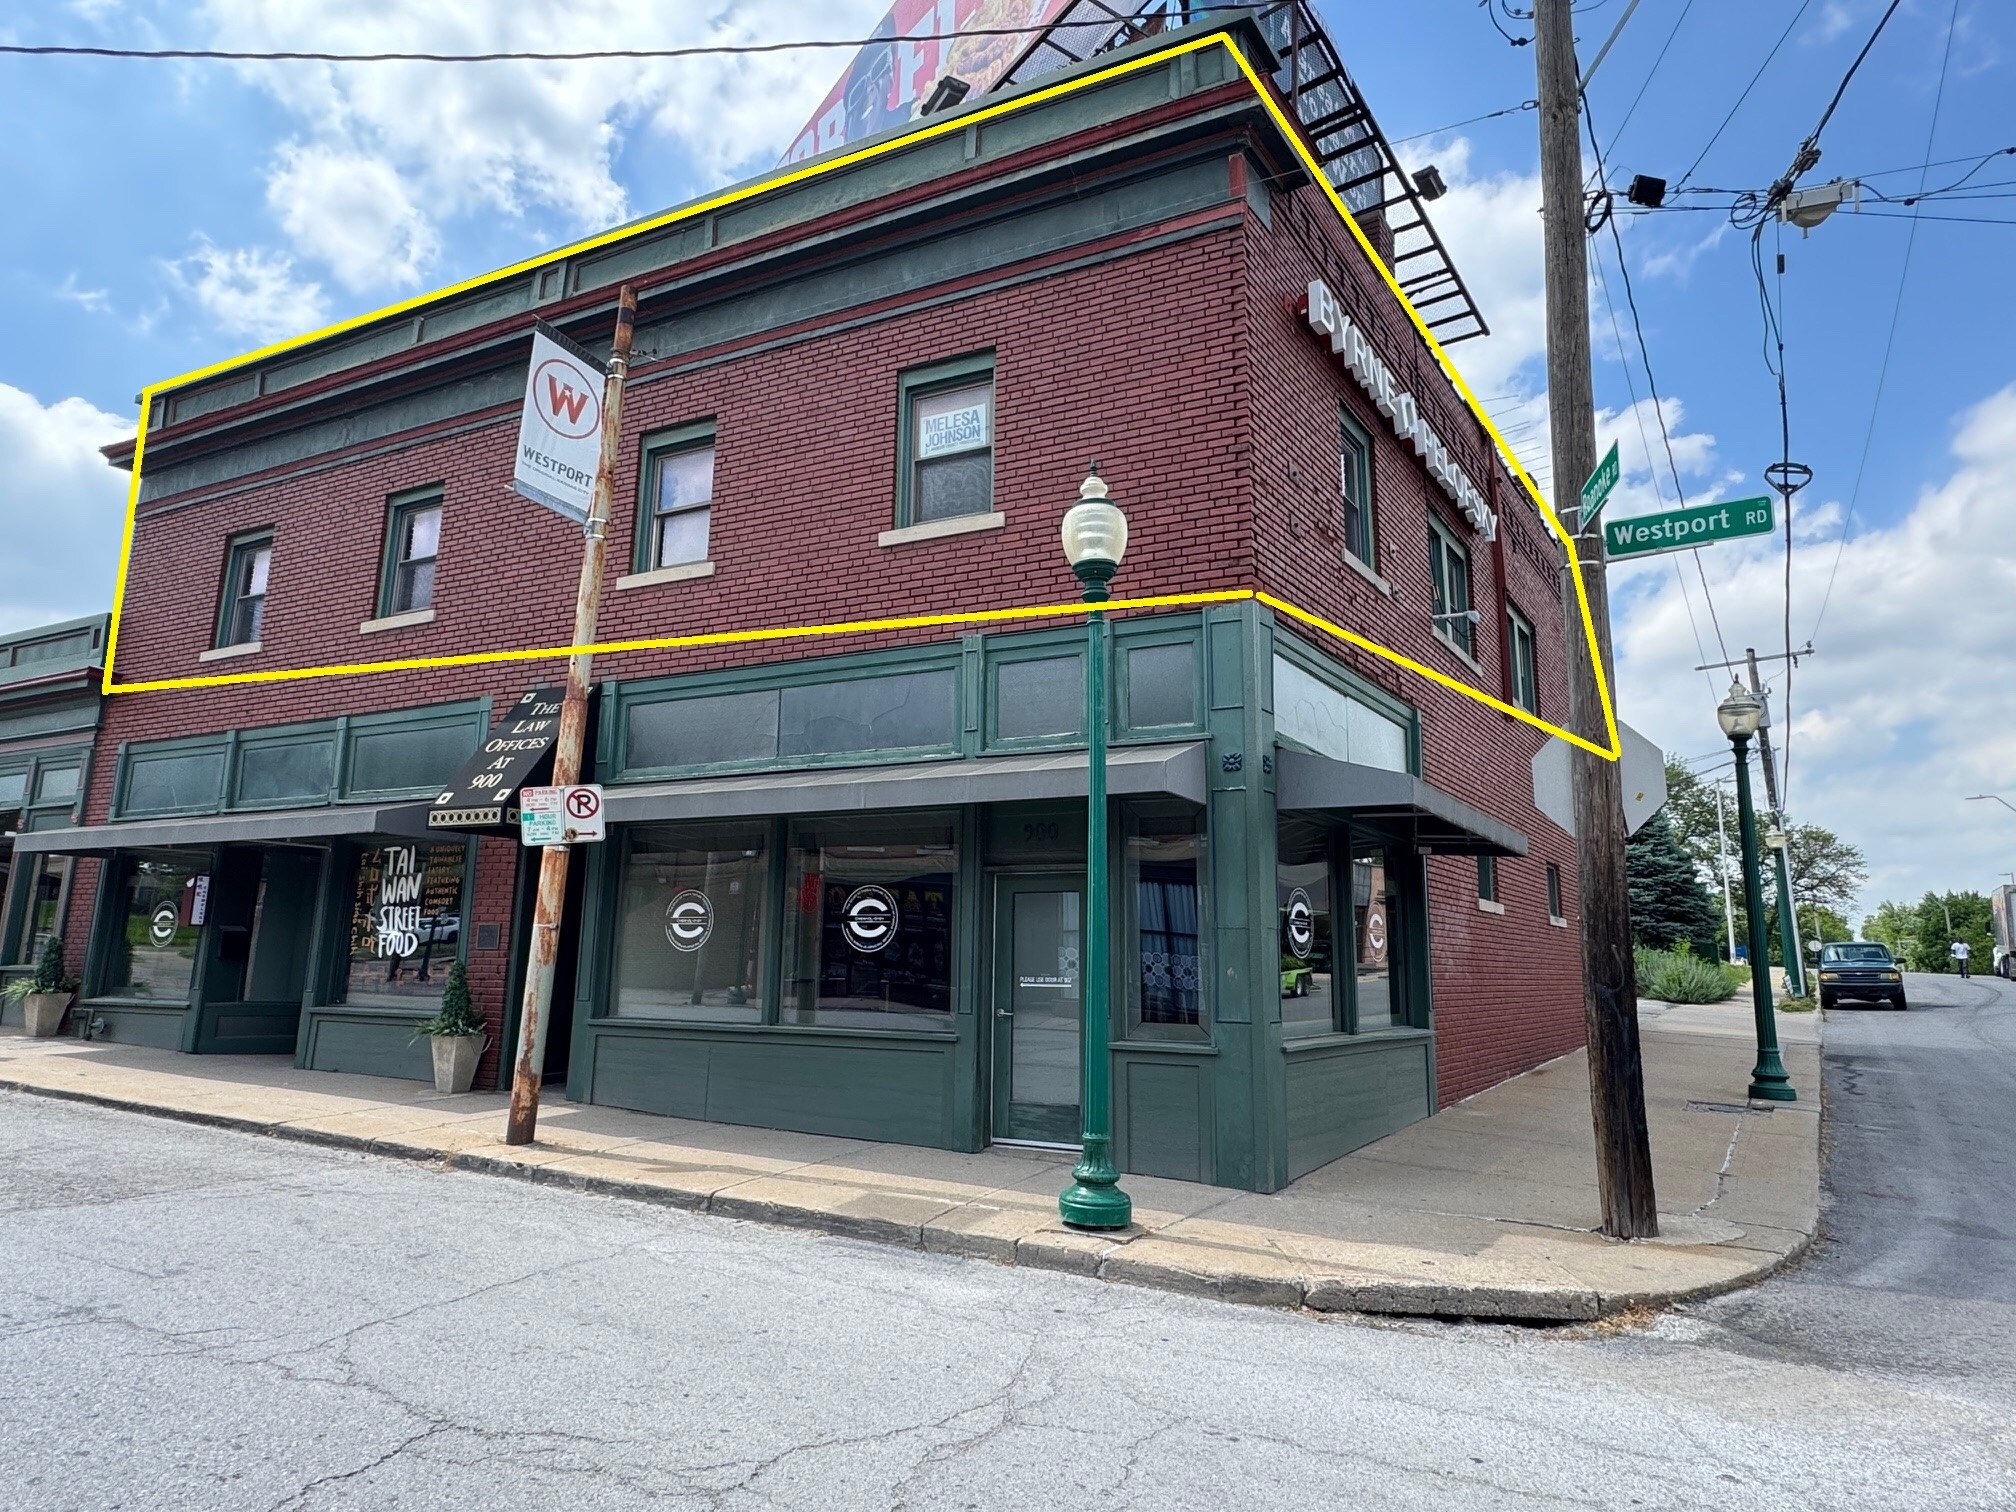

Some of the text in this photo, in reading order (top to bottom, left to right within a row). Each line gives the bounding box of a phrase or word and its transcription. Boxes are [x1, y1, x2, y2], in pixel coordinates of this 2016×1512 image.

[547, 373, 589, 425] W
[1308, 278, 1397, 418] BYRNE
[1415, 418, 1498, 542] PELOFSKY
[925, 409, 980, 434] MELESA
[925, 424, 980, 448] JOHNSON
[523, 444, 593, 487] WESTPORT
[1582, 466, 1611, 520] Roanoke
[1613, 508, 1767, 546] Westport RD
[530, 702, 562, 716] THE
[511, 720, 552, 734] LAW
[485, 736, 549, 753] OFFICES
[486, 755, 514, 770] AT
[467, 773, 503, 790] 900
[523, 788, 558, 797] NO PARKING
[384, 845, 416, 876] TAI
[381, 873, 422, 905] WAN
[425, 886, 458, 895] AUTHENTIC
[427, 876, 459, 885] FEATURING
[423, 908, 439, 916] FOOD
[424, 897, 454, 906] COMFORT
[376, 906, 421, 931] STREET
[378, 931, 418, 958] FOOD
